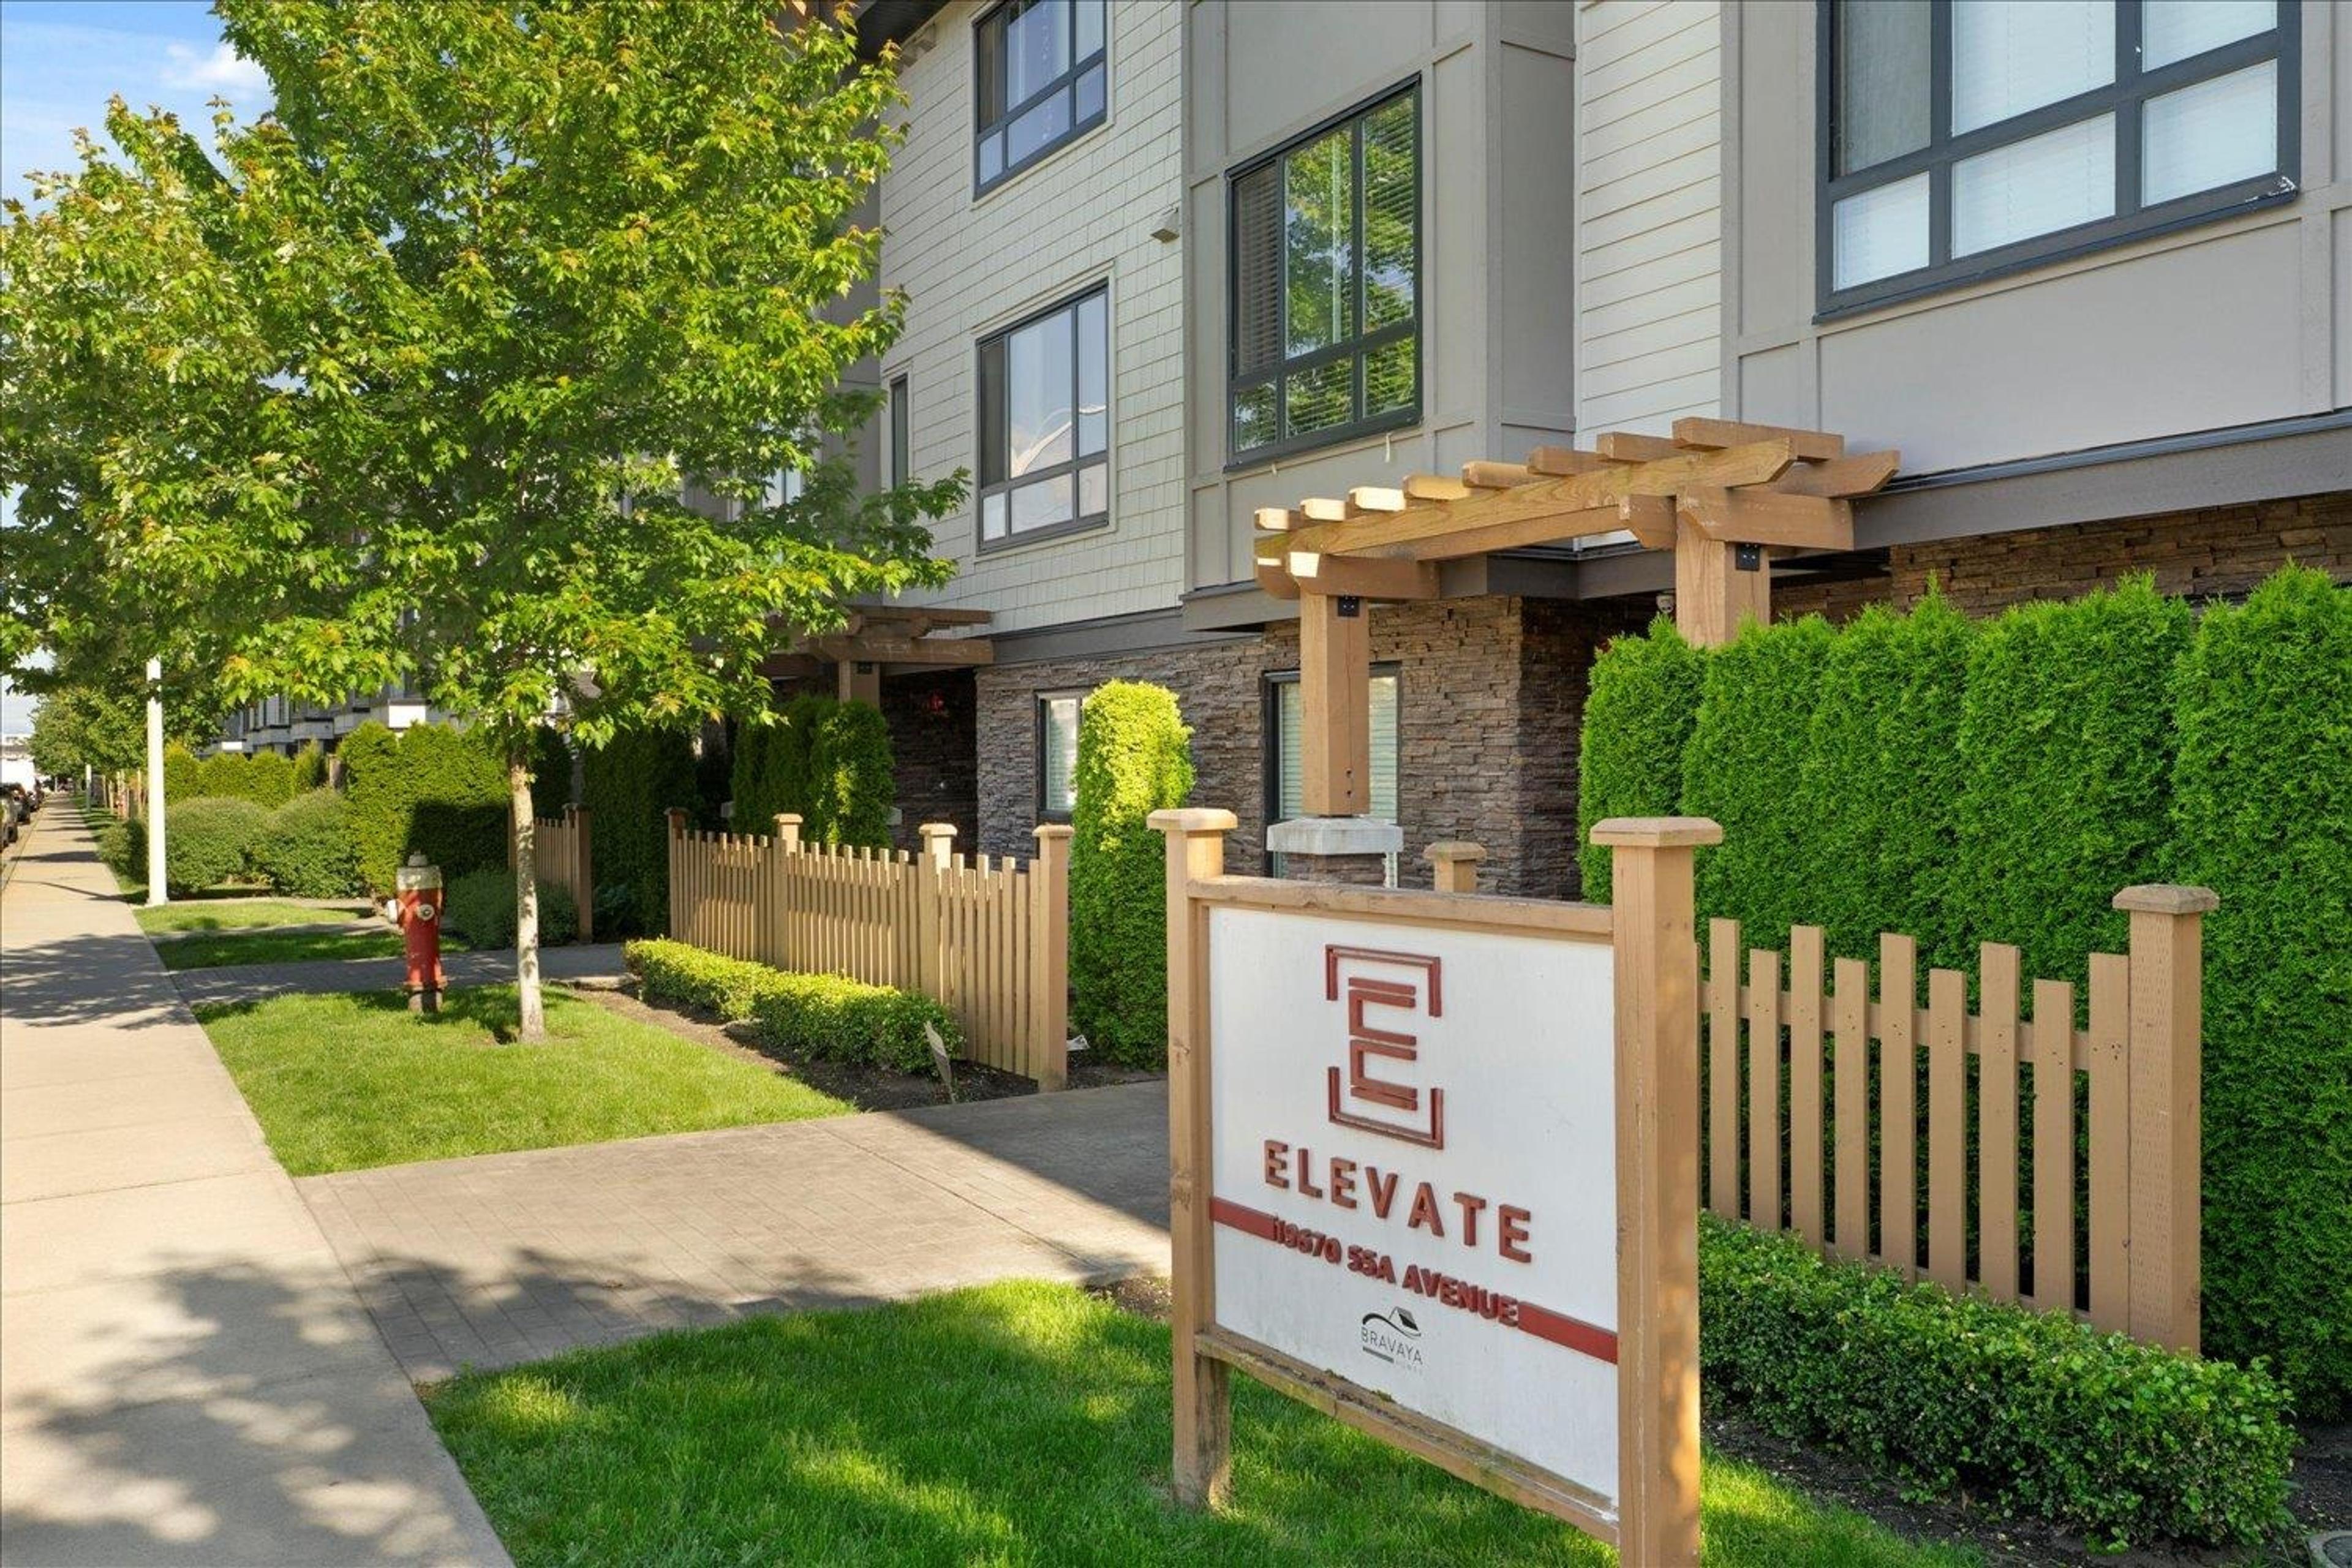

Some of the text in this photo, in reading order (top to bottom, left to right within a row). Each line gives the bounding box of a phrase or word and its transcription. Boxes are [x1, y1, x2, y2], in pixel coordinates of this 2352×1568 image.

[1264, 1139, 1532, 1264] ELEVATE
[1347, 1244, 1396, 1284] 55A
[1401, 1264, 1520, 1327] AVENUE
[1361, 1326, 1423, 1366] BRAVAYA
